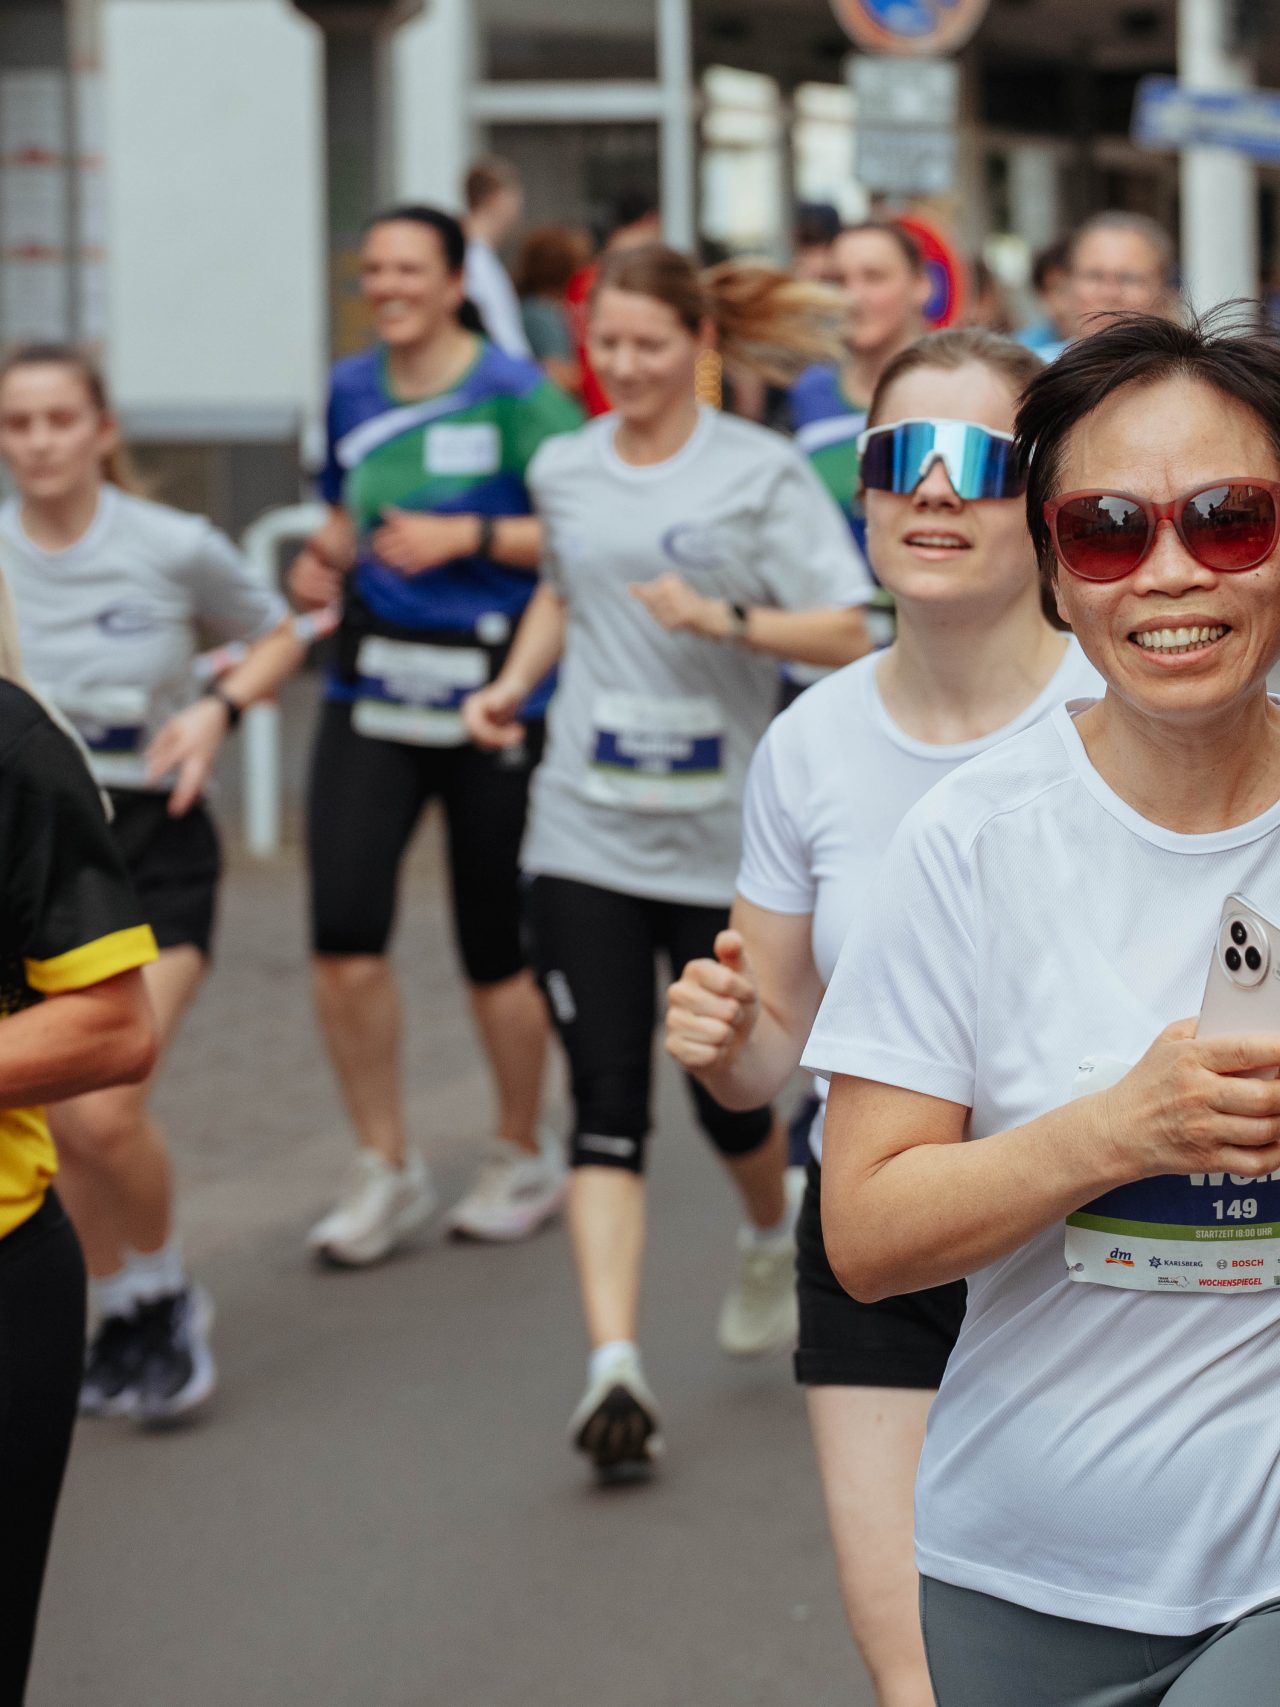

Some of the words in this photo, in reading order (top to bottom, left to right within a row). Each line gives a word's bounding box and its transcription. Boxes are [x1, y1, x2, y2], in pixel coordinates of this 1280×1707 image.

[1212, 1198, 1258, 1220] 149
[1195, 1229, 1234, 1239] STARTZEIT
[1256, 1227, 1273, 1237] UHR
[1109, 1247, 1132, 1260] dm
[1231, 1259, 1264, 1267] BOSCH
[1198, 1277, 1263, 1287] WOCHENSPIEGEL
